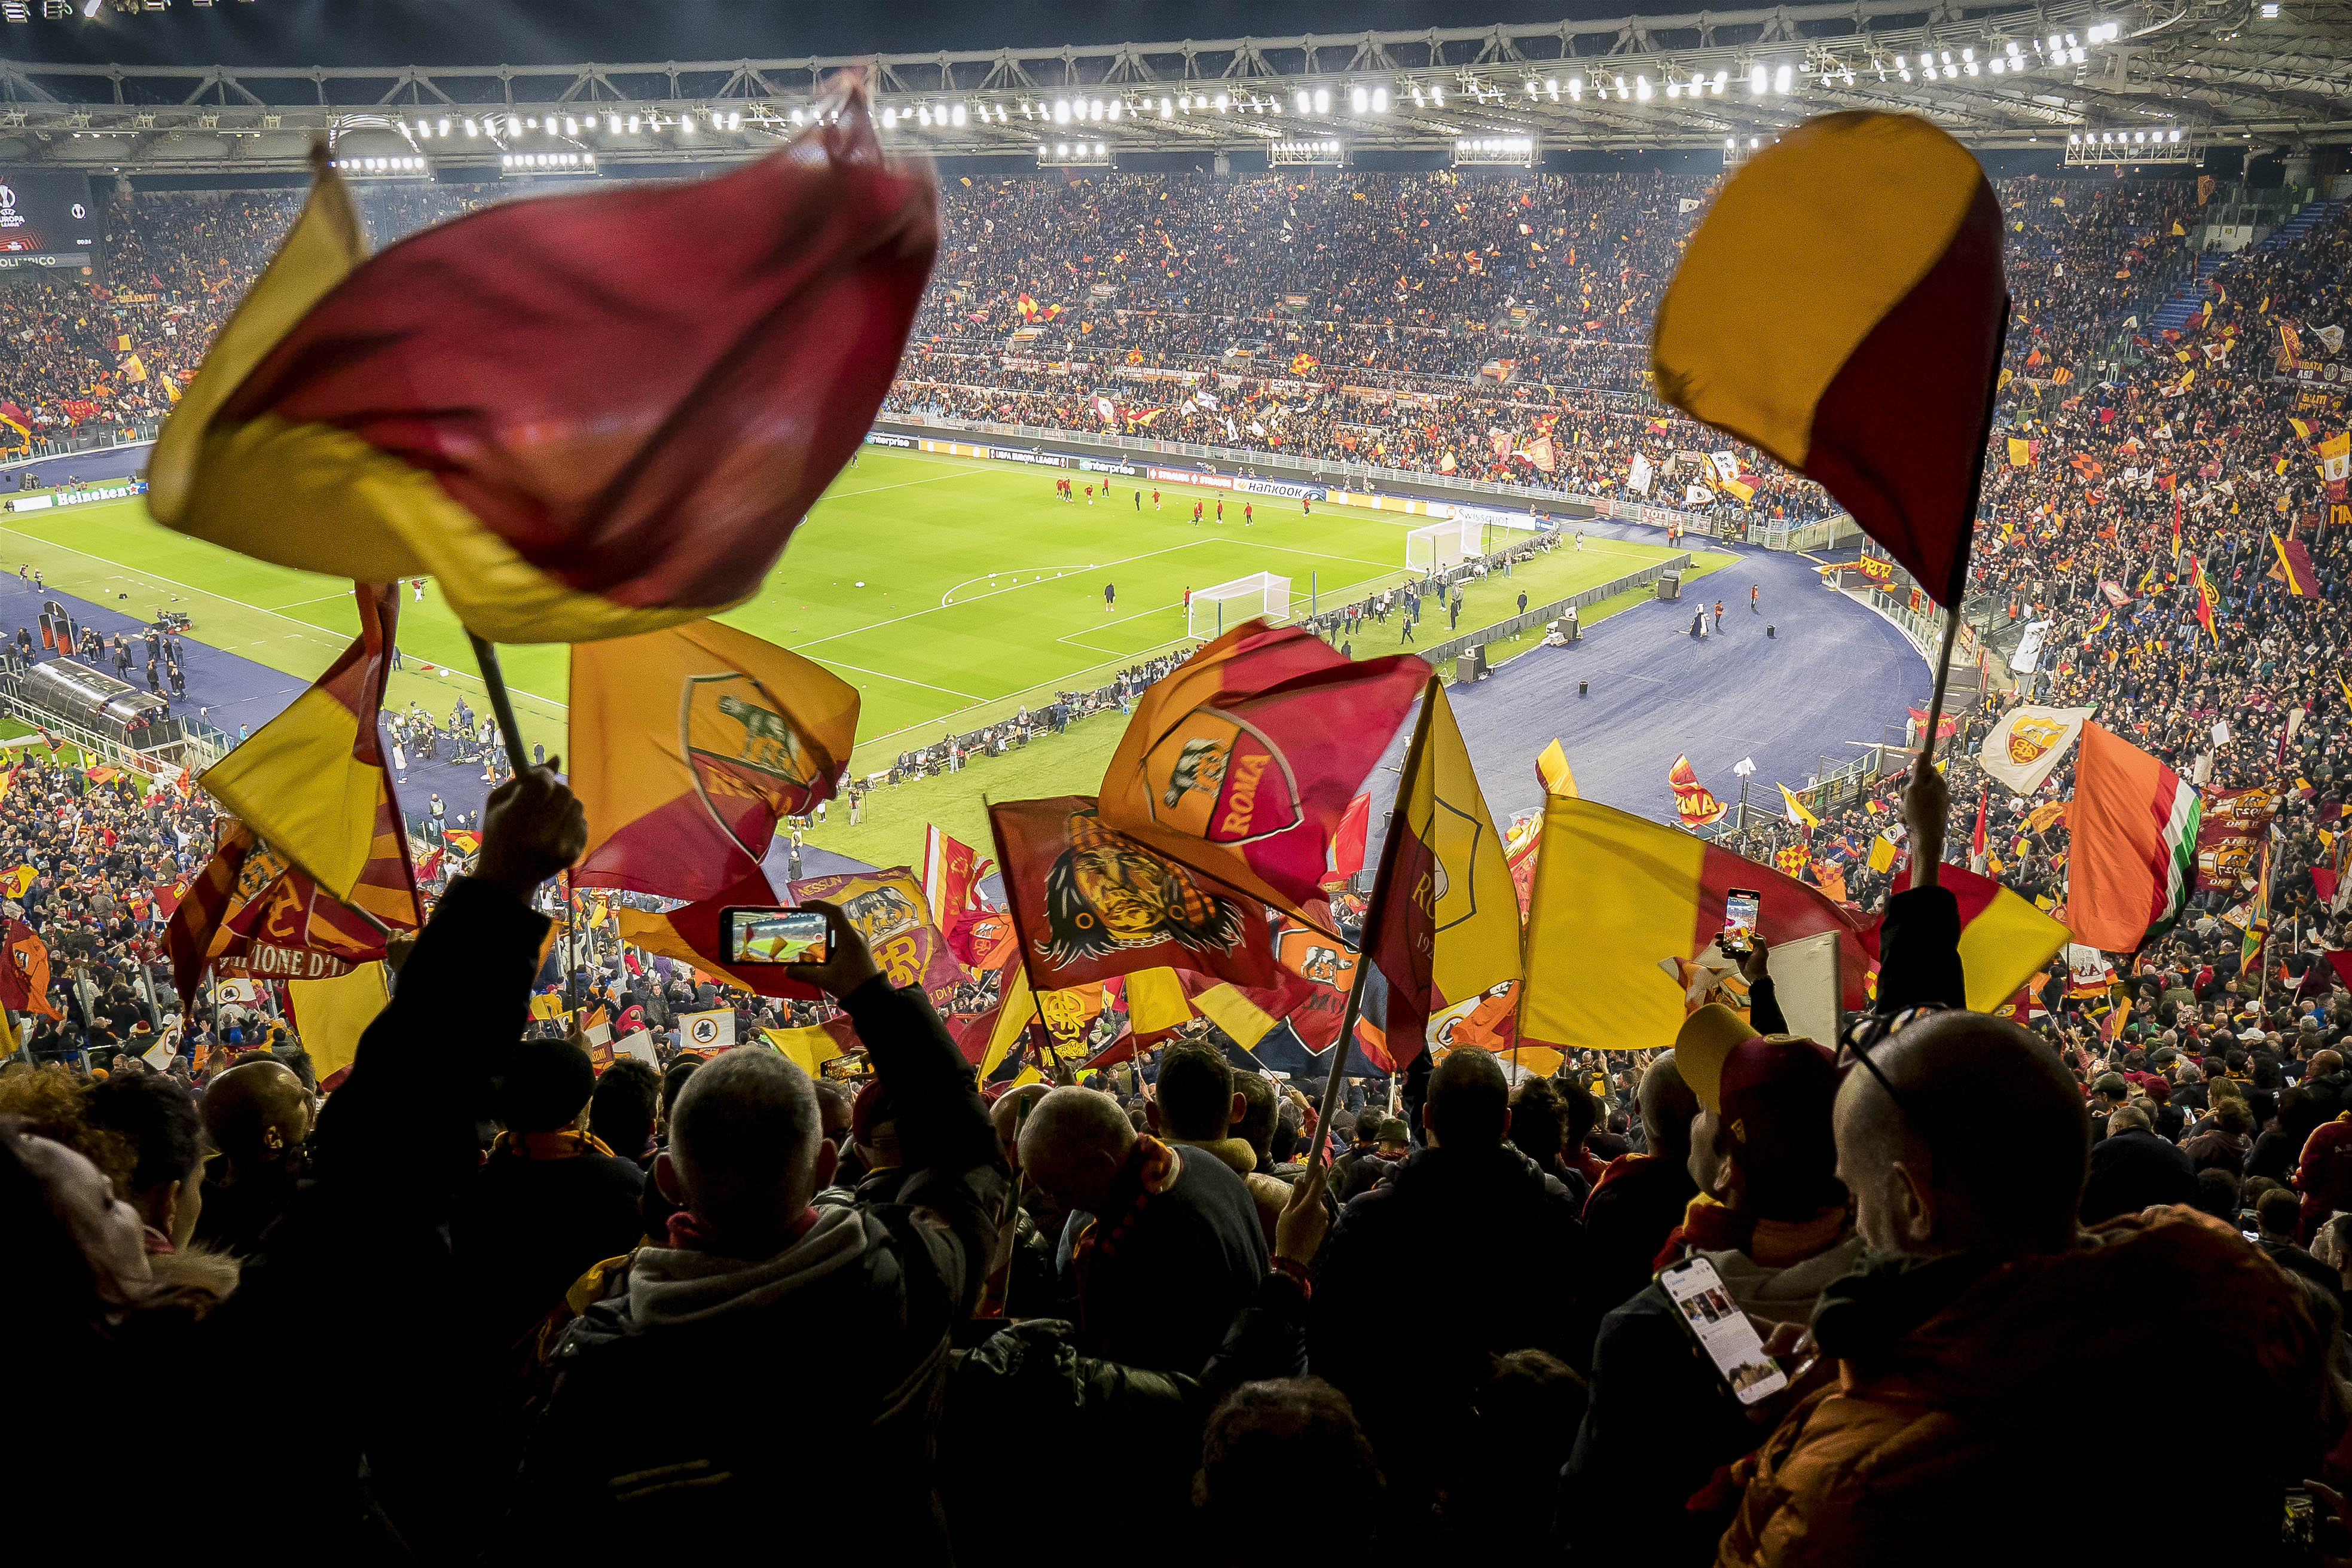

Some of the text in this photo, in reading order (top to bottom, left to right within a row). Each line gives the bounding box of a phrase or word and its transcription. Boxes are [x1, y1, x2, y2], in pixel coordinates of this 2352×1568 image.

[2298, 360, 2323, 372] RIGATA
[1272, 379, 1300, 388] COMO
[865, 434, 911, 448] enterprise
[995, 450, 1059, 466] UEFA EUROPA LEAGUE
[1080, 459, 1136, 475] enterprise
[56, 487, 127, 506] Heineken
[1221, 754, 1272, 836] ROMA
